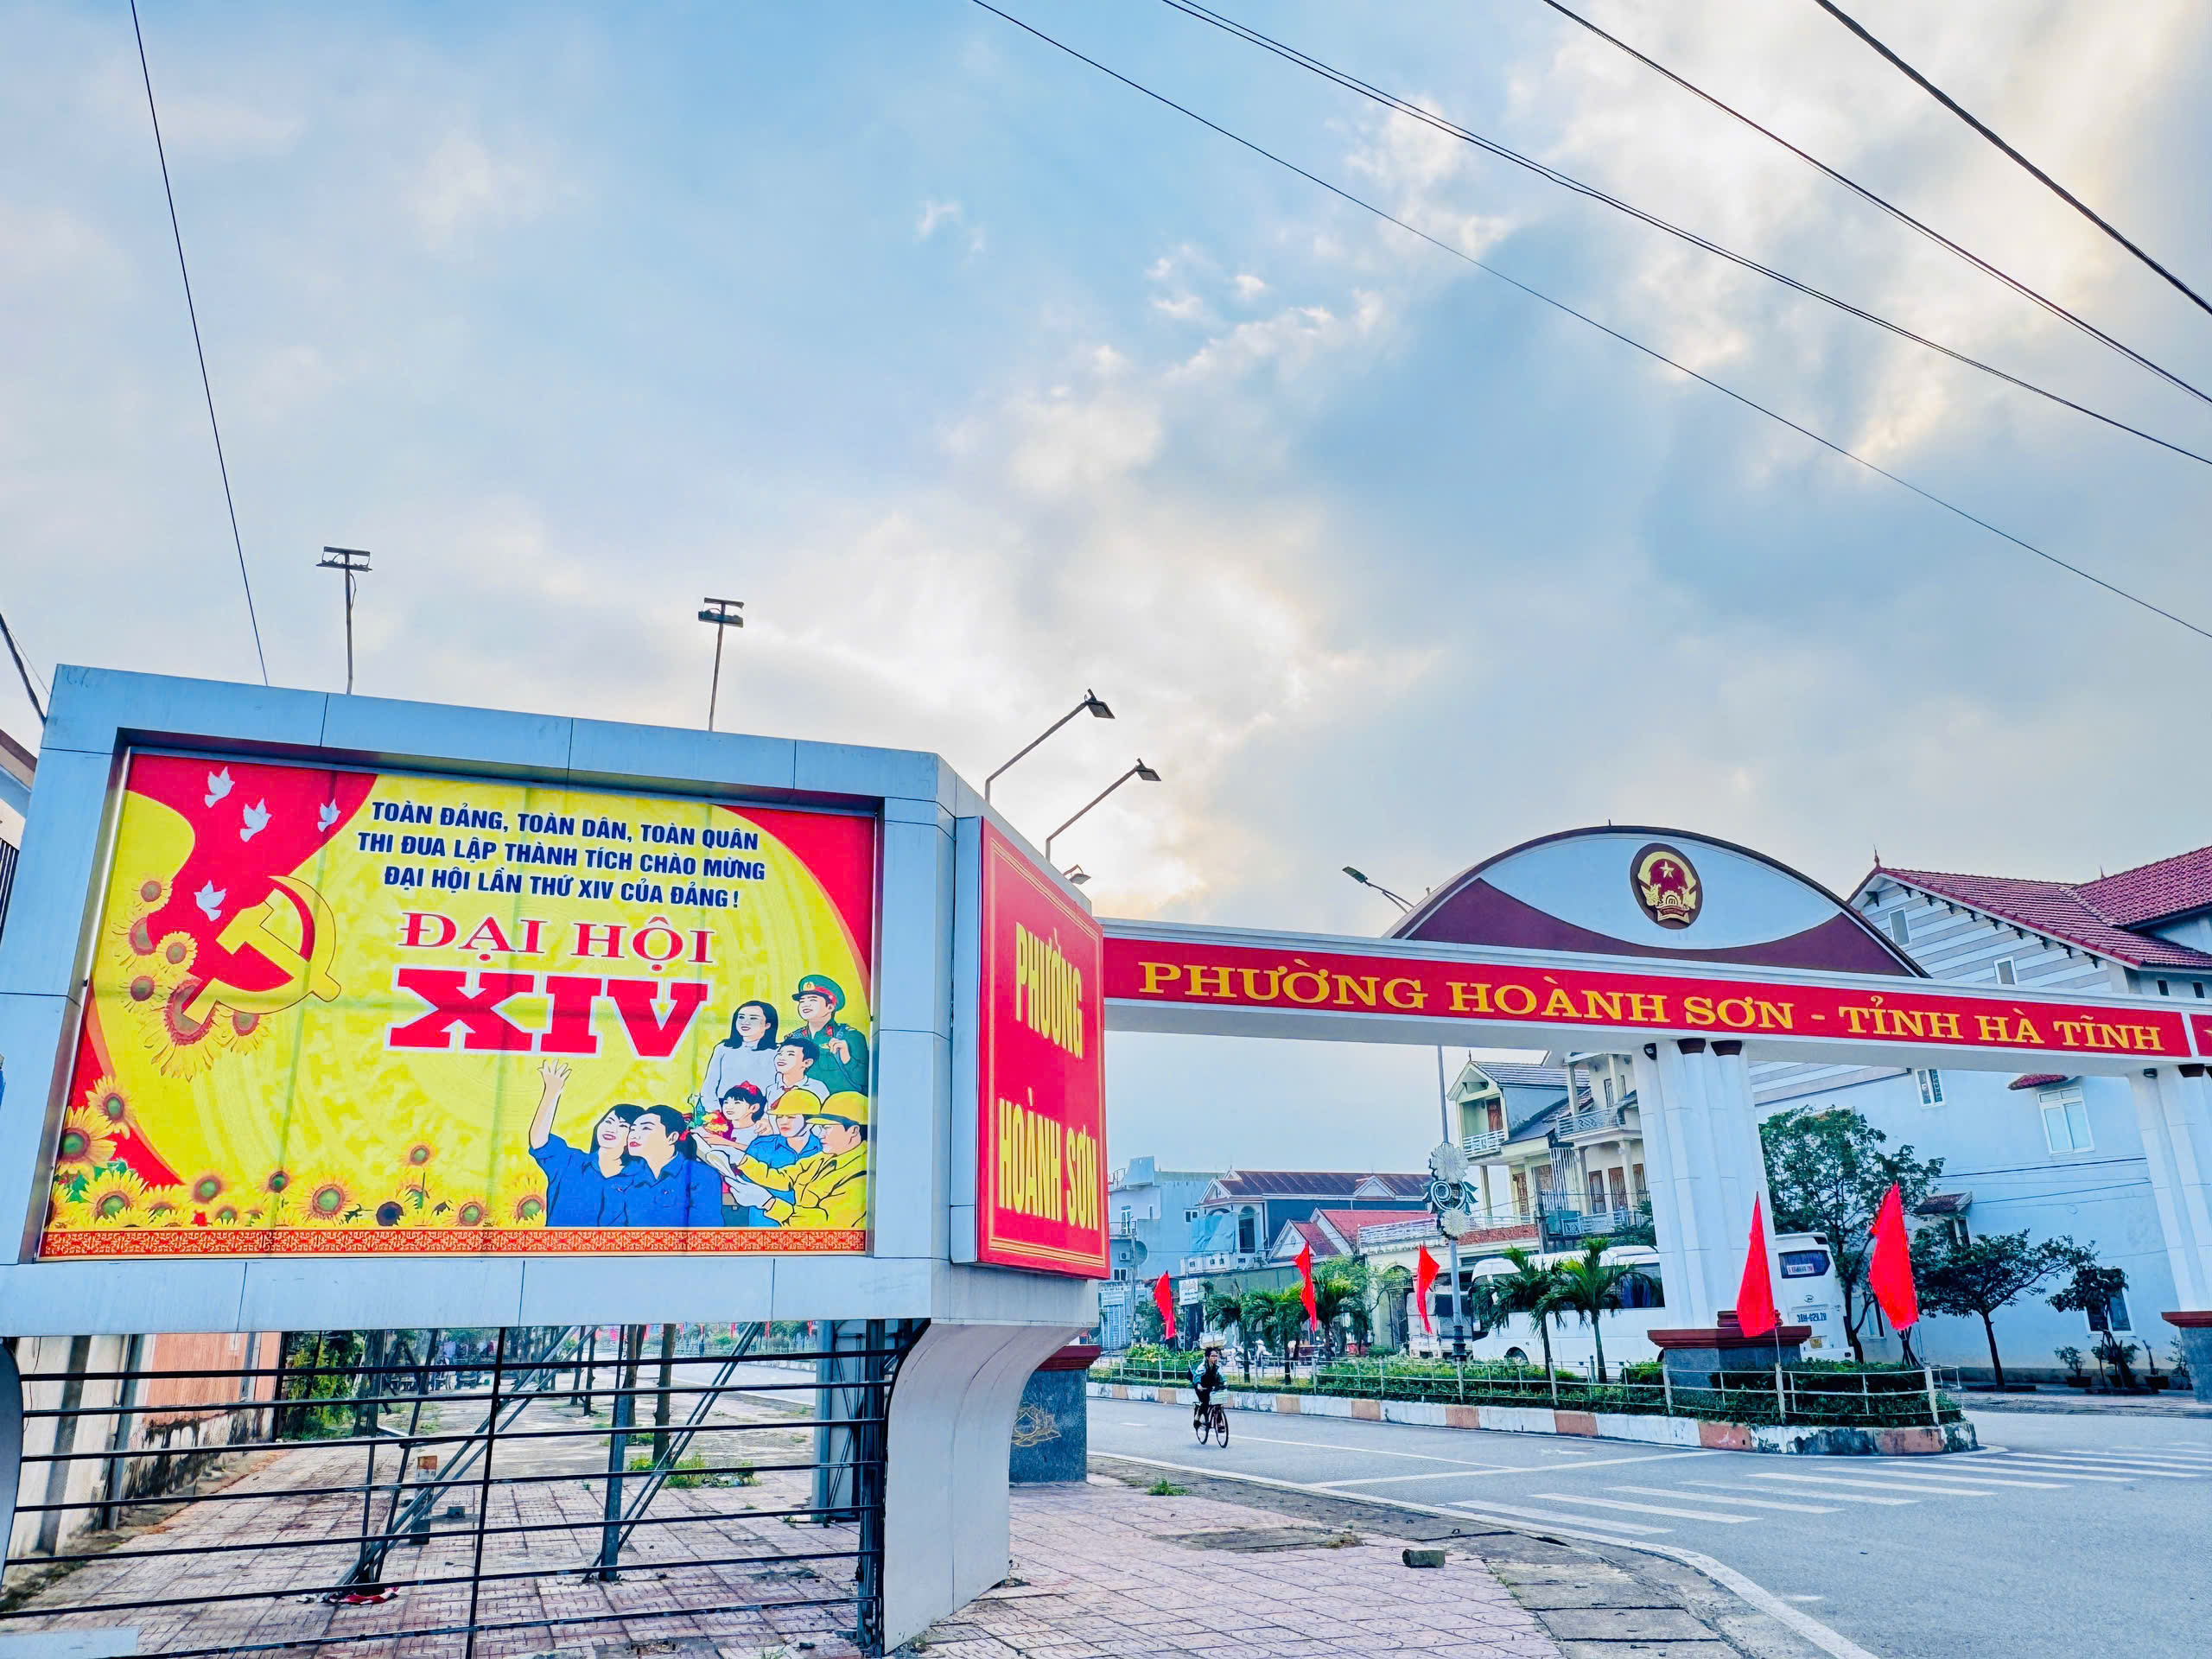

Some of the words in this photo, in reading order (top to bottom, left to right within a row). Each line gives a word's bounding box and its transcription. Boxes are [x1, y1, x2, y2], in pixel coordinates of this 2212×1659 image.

[359, 832, 393, 853] THI
[401, 836, 445, 856] ĐUA
[454, 837, 497, 862] LẬP
[505, 842, 576, 866] THÀNH
[586, 847, 632, 870] TÍCH
[640, 853, 696, 874] CHÀO
[703, 857, 765, 880] MỪNG
[372, 801, 432, 823] TOÀN
[440, 803, 508, 832] ĐẢNG,
[518, 812, 575, 836] TOÀN
[582, 817, 632, 842] DÂN,
[641, 823, 695, 845] TOÀN
[702, 829, 758, 850] QUÂN
[385, 866, 423, 890] ĐẠI
[432, 867, 470, 893] HỘI
[478, 868, 522, 893] LẦN
[530, 874, 574, 896] THỨ
[578, 880, 614, 899] XIV
[620, 878, 663, 903] CỦA
[397, 912, 547, 961] ĐẠI
[570, 917, 715, 971] HỘI
[390, 968, 708, 1057] XIV
[1016, 922, 1083, 1059] PHƯỜNG
[1138, 958, 1428, 1008] PHƯỜNG
[1446, 976, 1671, 1023] HOÀNH
[1686, 995, 1795, 1030] SƠN
[1839, 995, 1964, 1039] TỈNH
[1974, 1008, 2044, 1044] HÀ
[2053, 1014, 2165, 1051] TĨNH
[999, 1087, 1062, 1222] HOÀNH
[1066, 1125, 1098, 1230] SƠN
